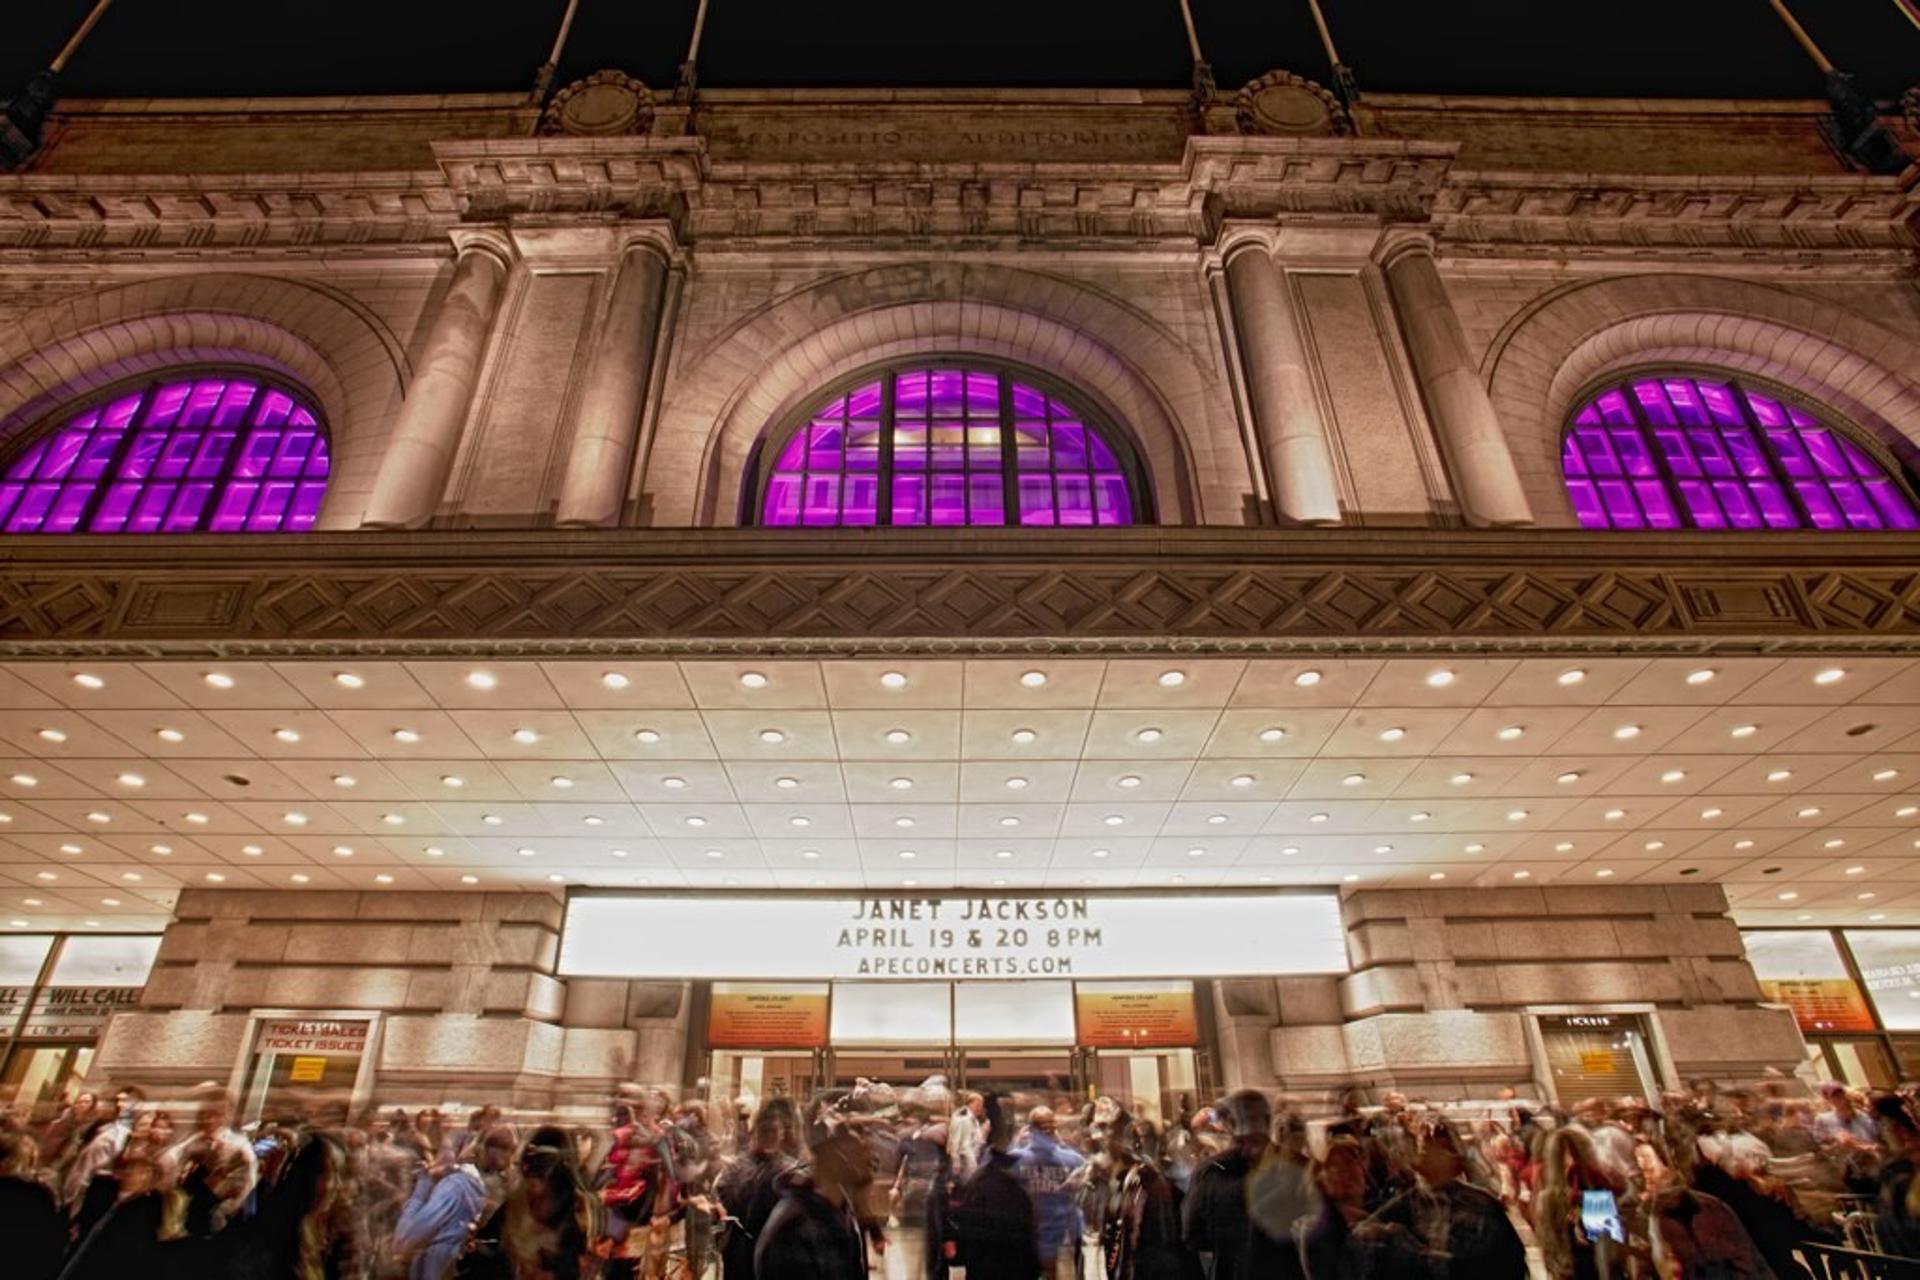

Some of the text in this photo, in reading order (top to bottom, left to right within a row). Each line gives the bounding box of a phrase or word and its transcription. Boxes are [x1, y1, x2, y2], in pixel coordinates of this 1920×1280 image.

[852, 899, 1088, 920] JANET JACKSON
[837, 928, 914, 947] APRIL
[930, 929, 954, 947] 19
[967, 929, 982, 948] &
[996, 928, 1028, 947] 20
[857, 956, 1072, 975] APECONCERTS.COM
[49, 988, 138, 1004] WILL CALL
[271, 1024, 317, 1036] TICKET
[265, 1039, 365, 1050] TICKET ISSUES
